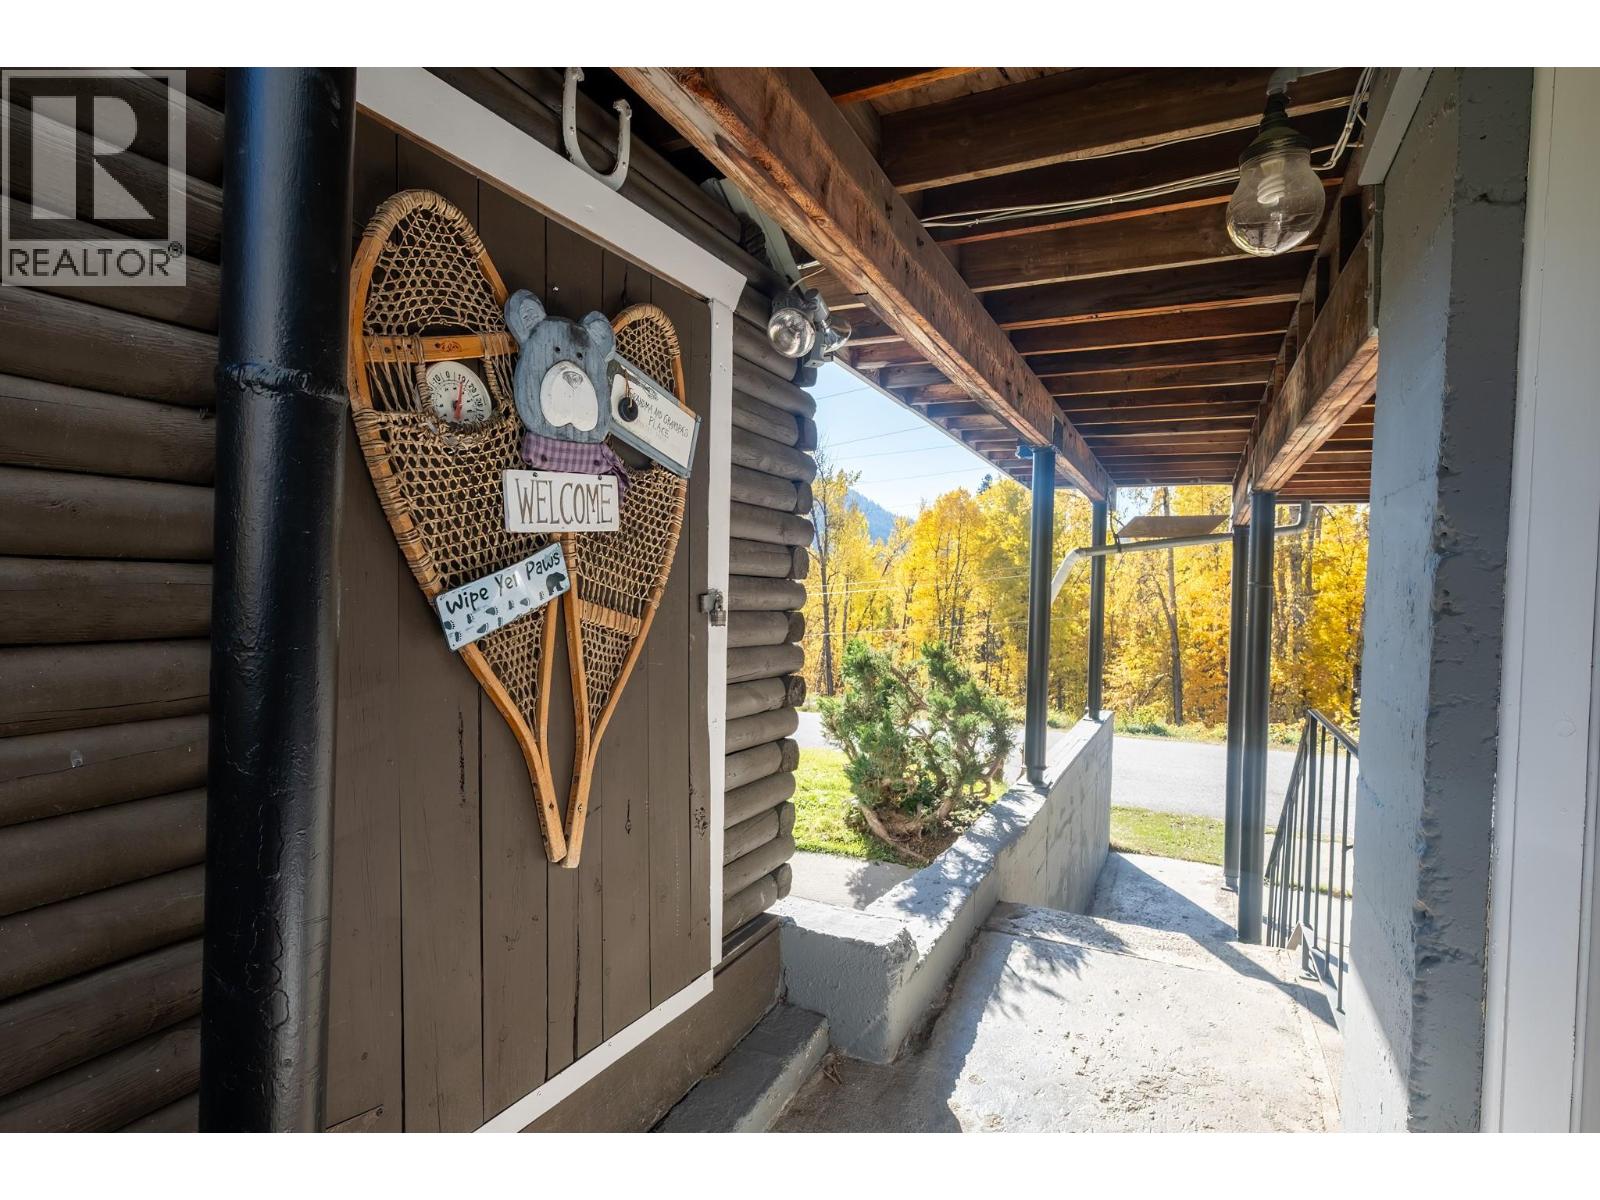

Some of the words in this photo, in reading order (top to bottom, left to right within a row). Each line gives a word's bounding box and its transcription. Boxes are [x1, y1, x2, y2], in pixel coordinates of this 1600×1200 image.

[648, 415, 670, 440] PLACE
[515, 478, 613, 525] WELCOME
[445, 587, 489, 615] Wipe
[494, 573, 518, 597] Yer
[525, 551, 561, 581] Paws
